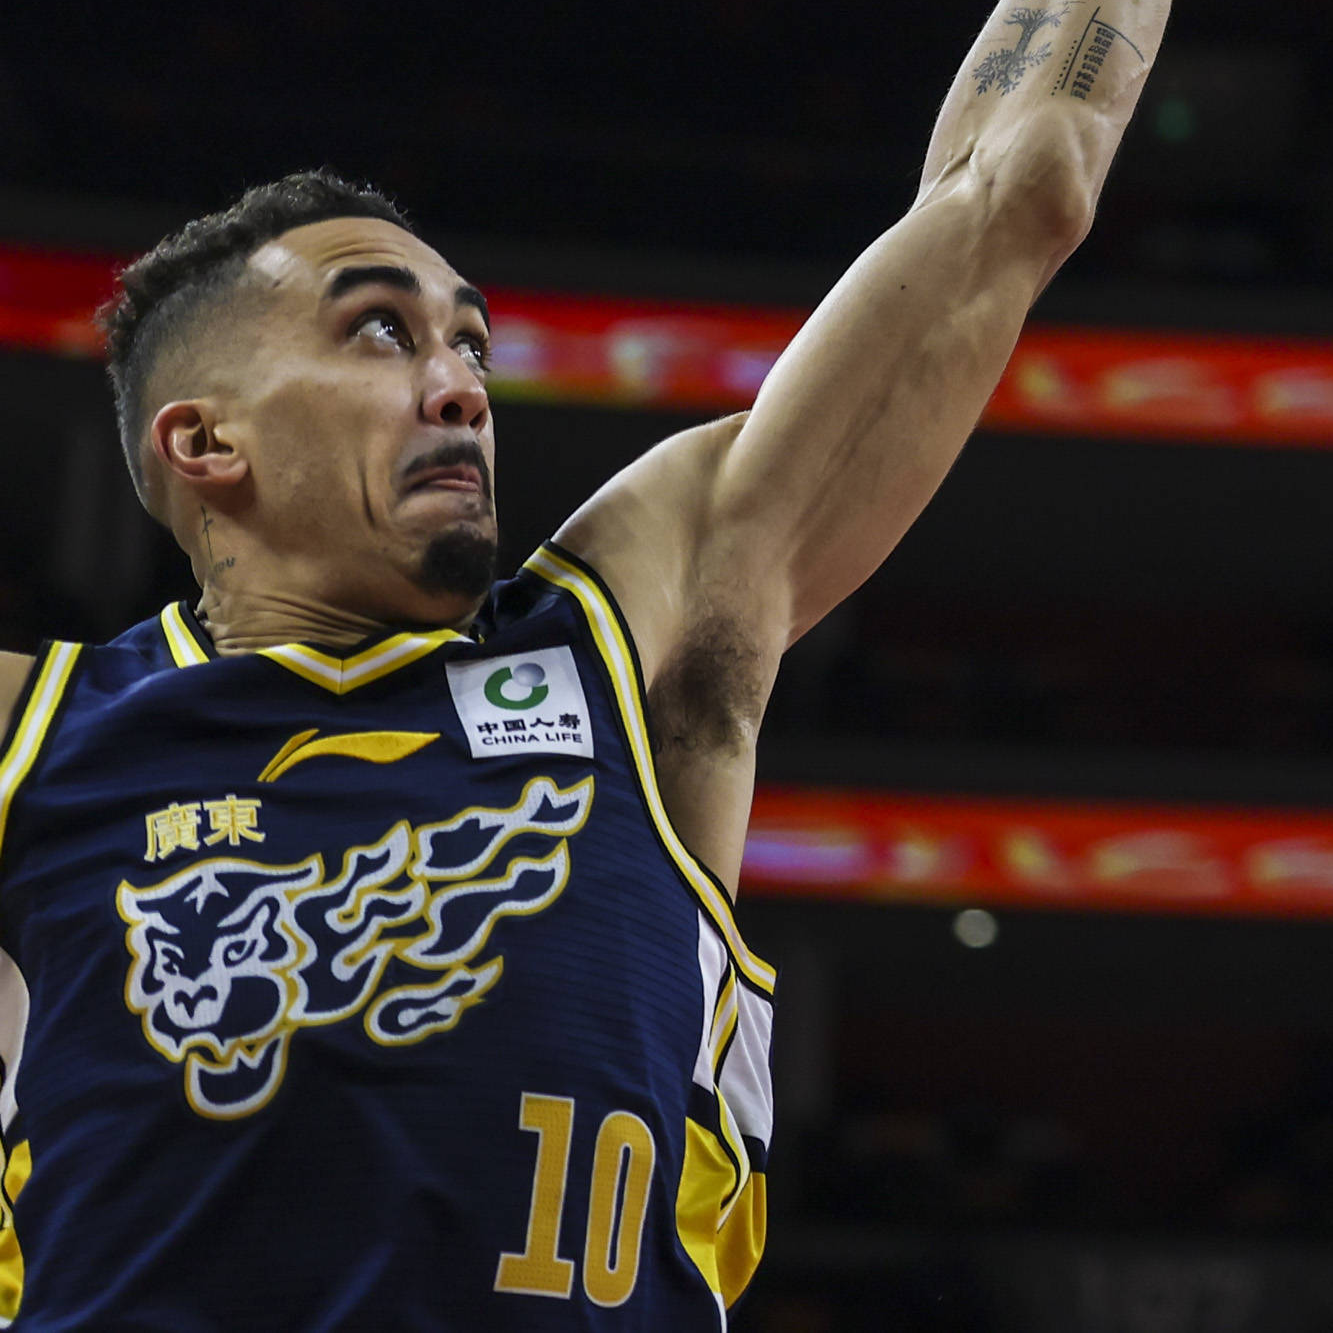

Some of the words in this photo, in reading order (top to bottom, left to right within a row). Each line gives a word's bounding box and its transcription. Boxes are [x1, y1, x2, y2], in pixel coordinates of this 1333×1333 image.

[476, 712, 582, 735] 中国人寿
[482, 733, 540, 746] CHINA
[545, 732, 583, 744] LIFE
[144, 792, 266, 863] 廣東
[493, 1091, 657, 1308] 10
